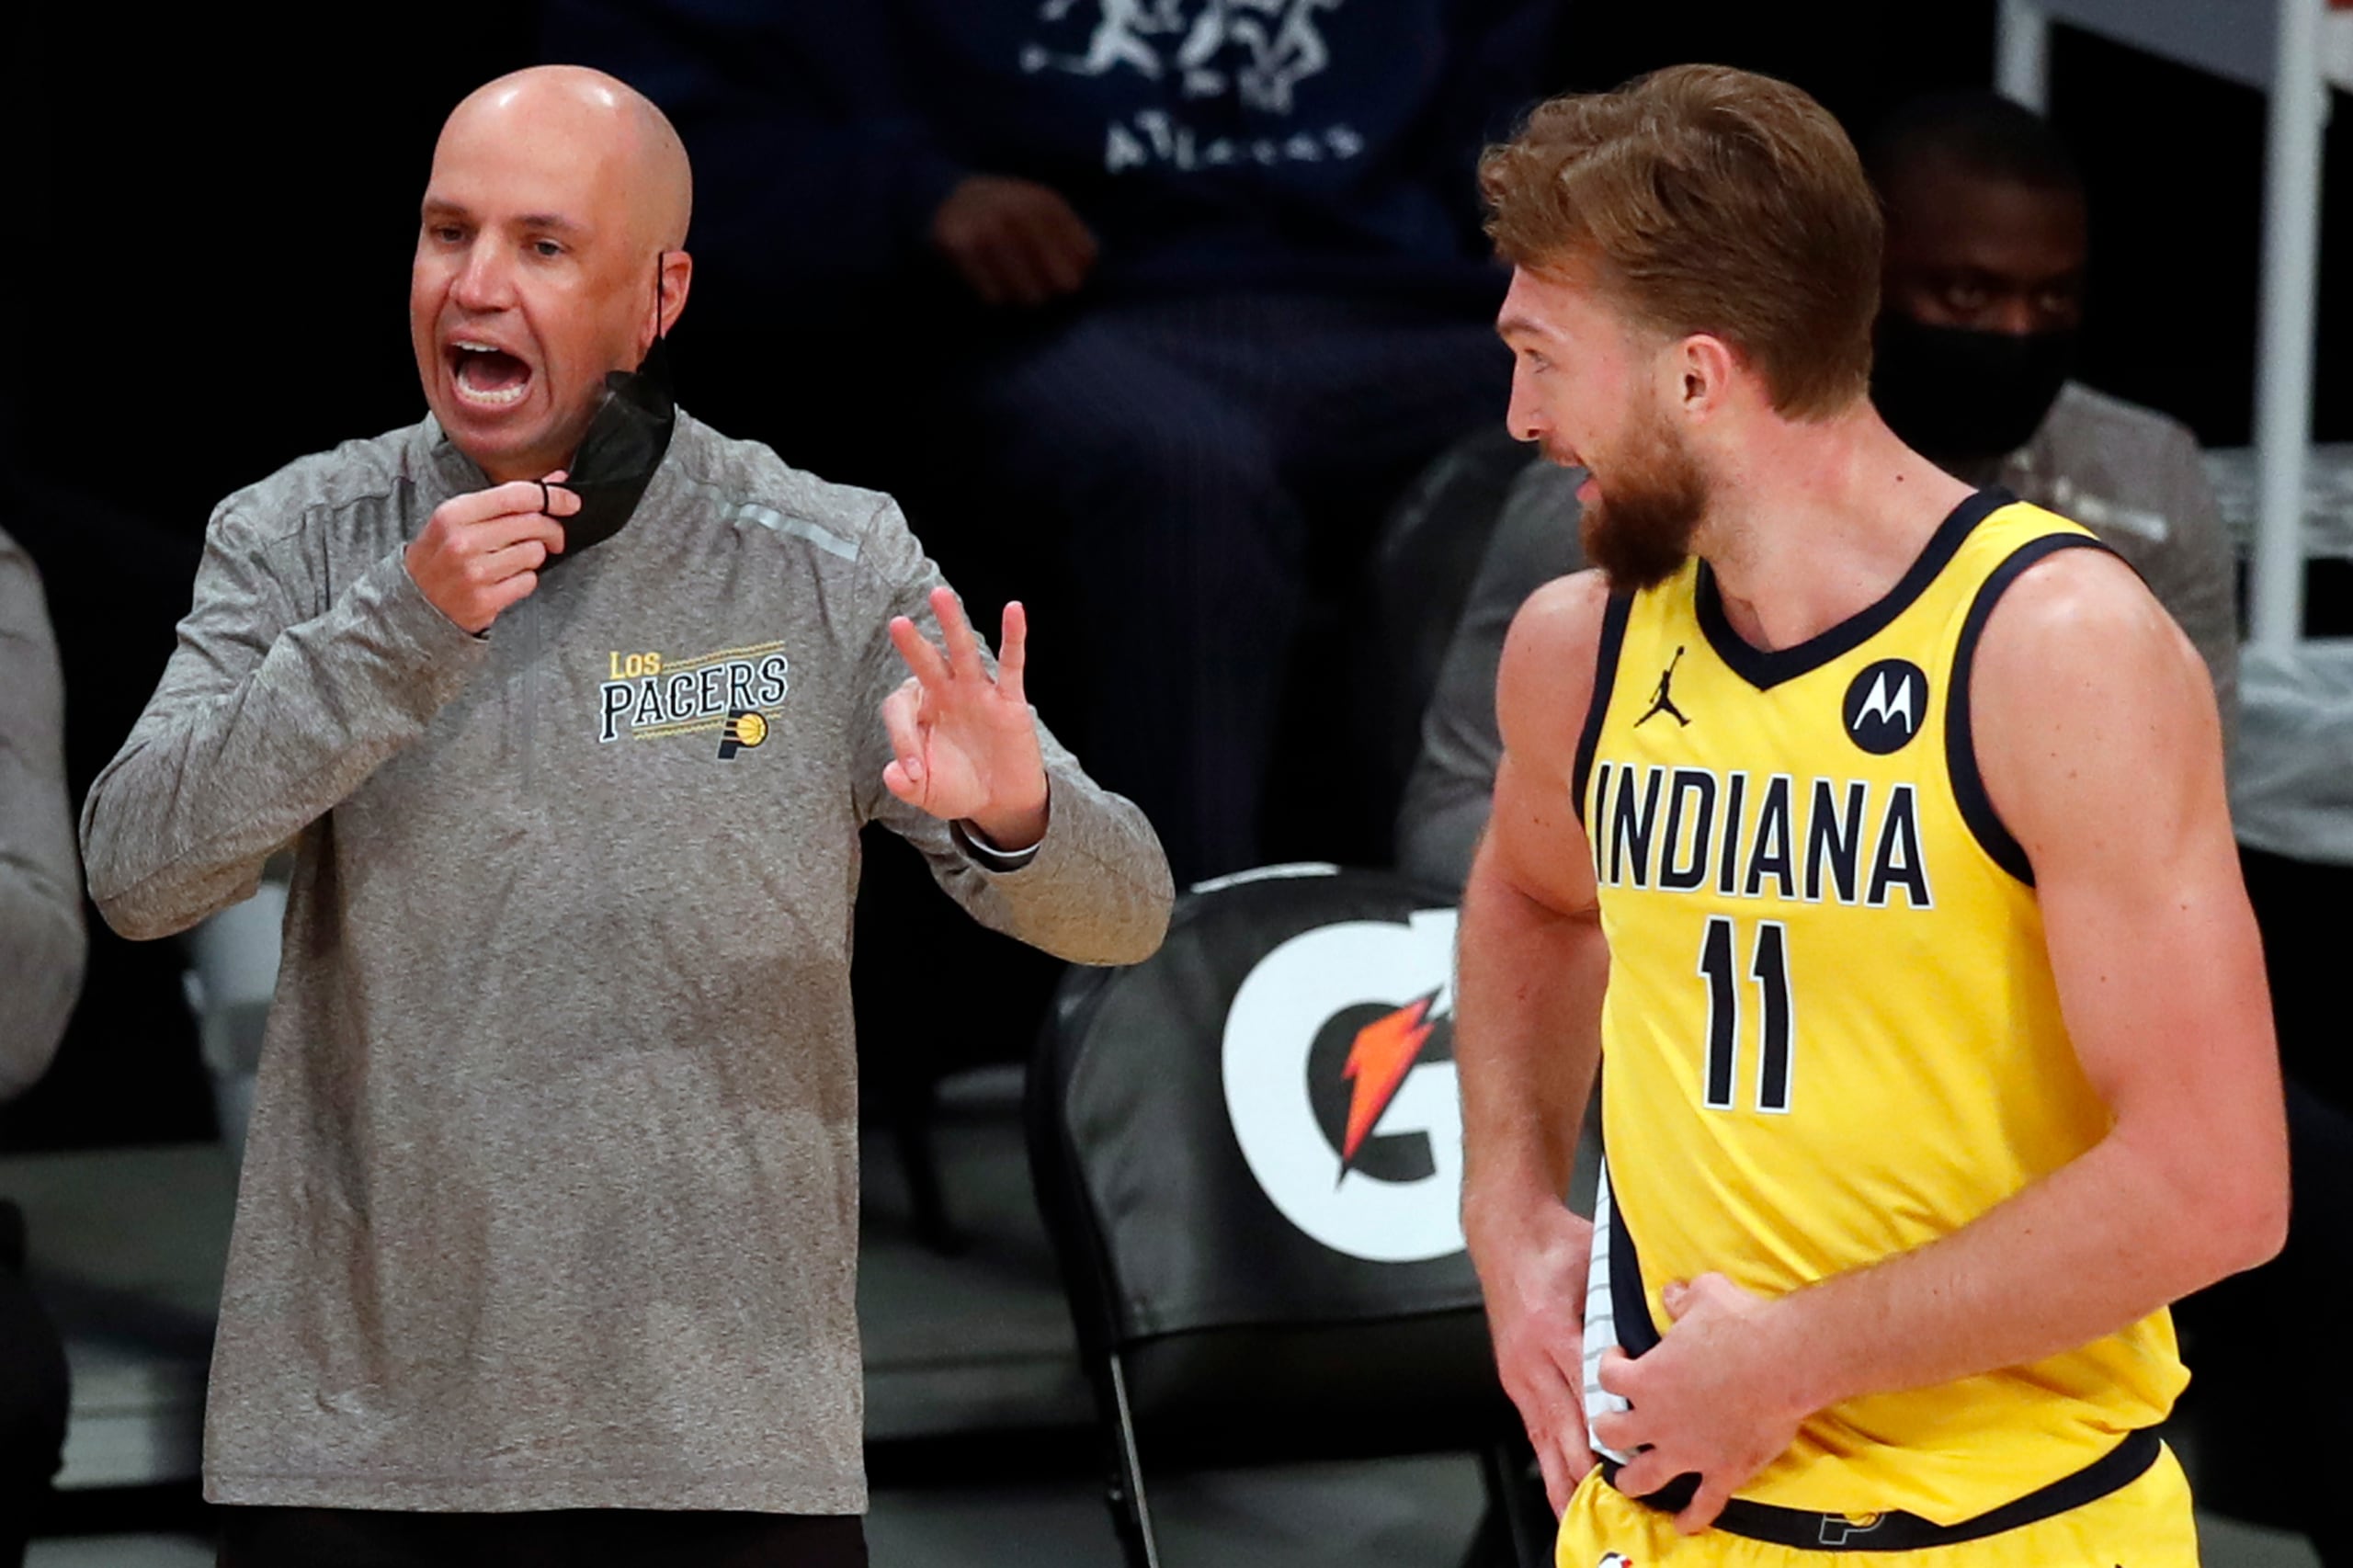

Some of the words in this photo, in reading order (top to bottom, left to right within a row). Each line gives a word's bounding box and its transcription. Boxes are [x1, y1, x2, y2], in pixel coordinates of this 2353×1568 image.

[598, 654, 789, 743] PACERS
[609, 651, 662, 679] LOS
[1595, 759, 1935, 911] INDIANA
[1222, 907, 1469, 1264] G
[1698, 914, 1793, 1114] 11
